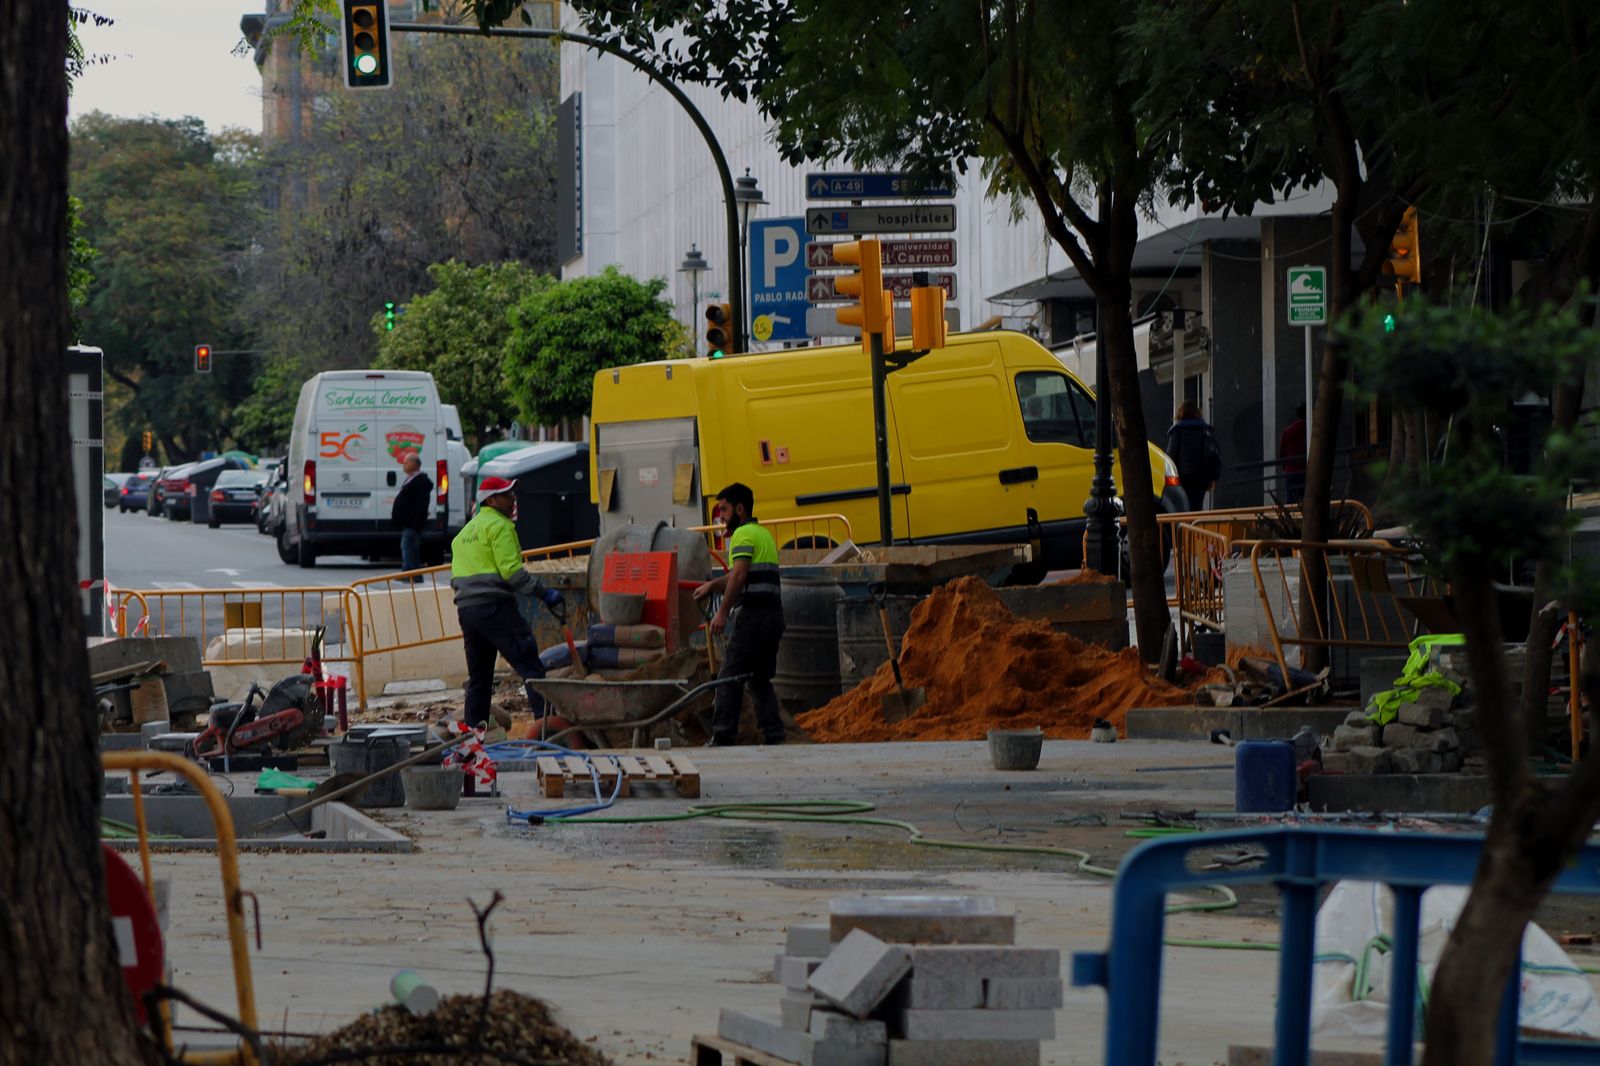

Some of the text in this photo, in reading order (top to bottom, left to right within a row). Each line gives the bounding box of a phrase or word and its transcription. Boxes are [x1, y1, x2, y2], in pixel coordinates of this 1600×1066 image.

[878, 213, 950, 226] hospitales
[893, 243, 949, 251] universidad
[764, 226, 799, 288] P
[897, 252, 950, 263] Carmen
[754, 292, 783, 303] PABLO
[325, 391, 427, 406] Santana Cordero
